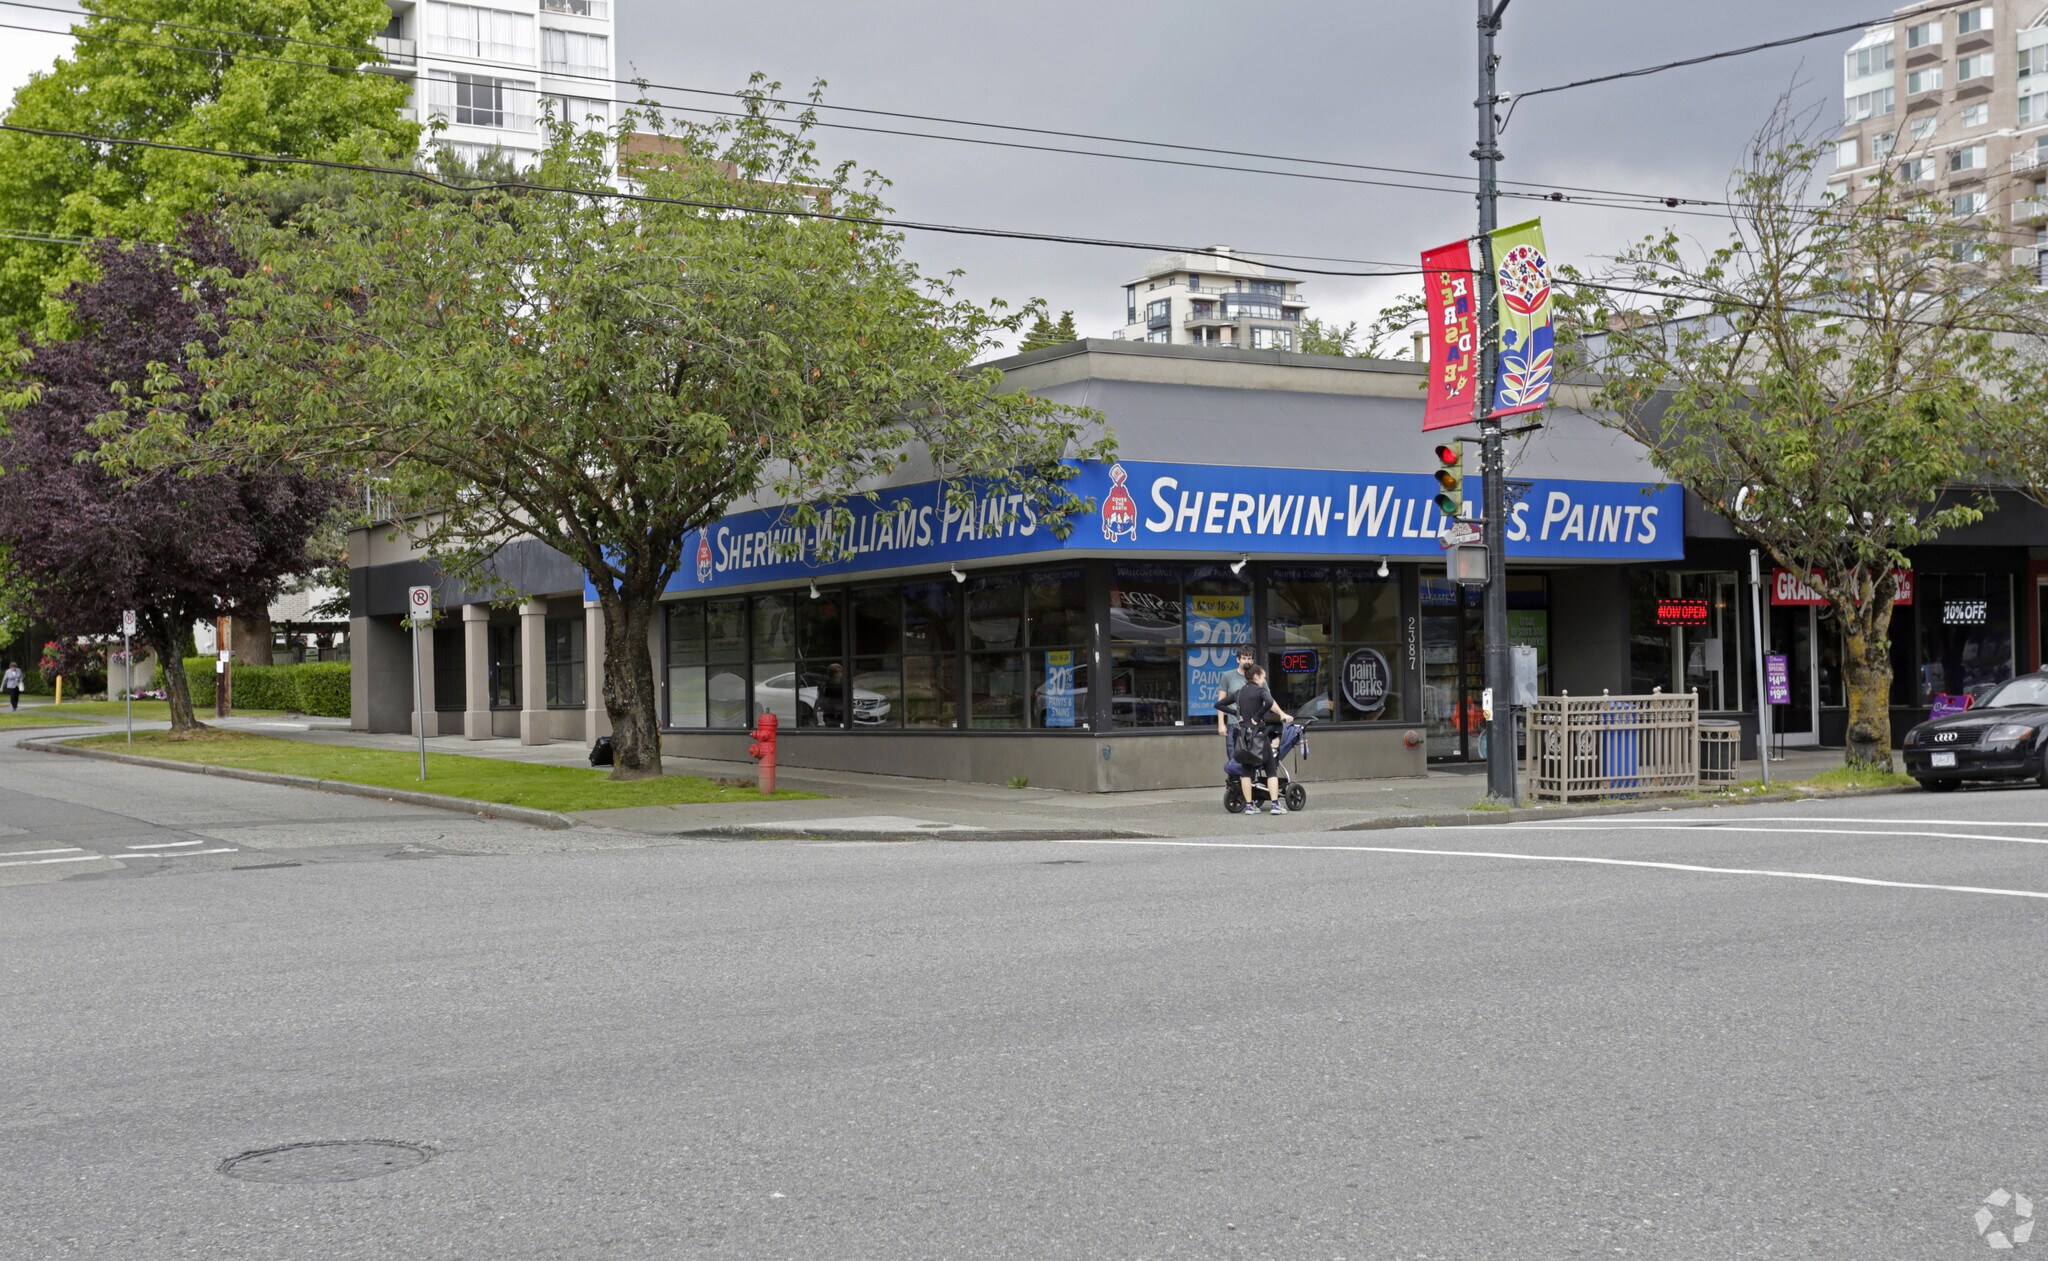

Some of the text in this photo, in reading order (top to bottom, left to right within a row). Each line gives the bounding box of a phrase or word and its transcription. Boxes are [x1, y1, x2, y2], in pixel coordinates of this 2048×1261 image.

[941, 493, 1038, 544] PAINTS
[1540, 491, 1659, 544] PAINTS
[1196, 600, 1240, 611] MAY 16-24
[1659, 605, 1707, 619] NOW OPEN
[1945, 605, 1985, 619] 10% OFF
[1408, 617, 1416, 670] 2387
[1350, 661, 1377, 682] paint
[1353, 677, 1383, 698] perks
[1049, 696, 1067, 707] PAINTS
